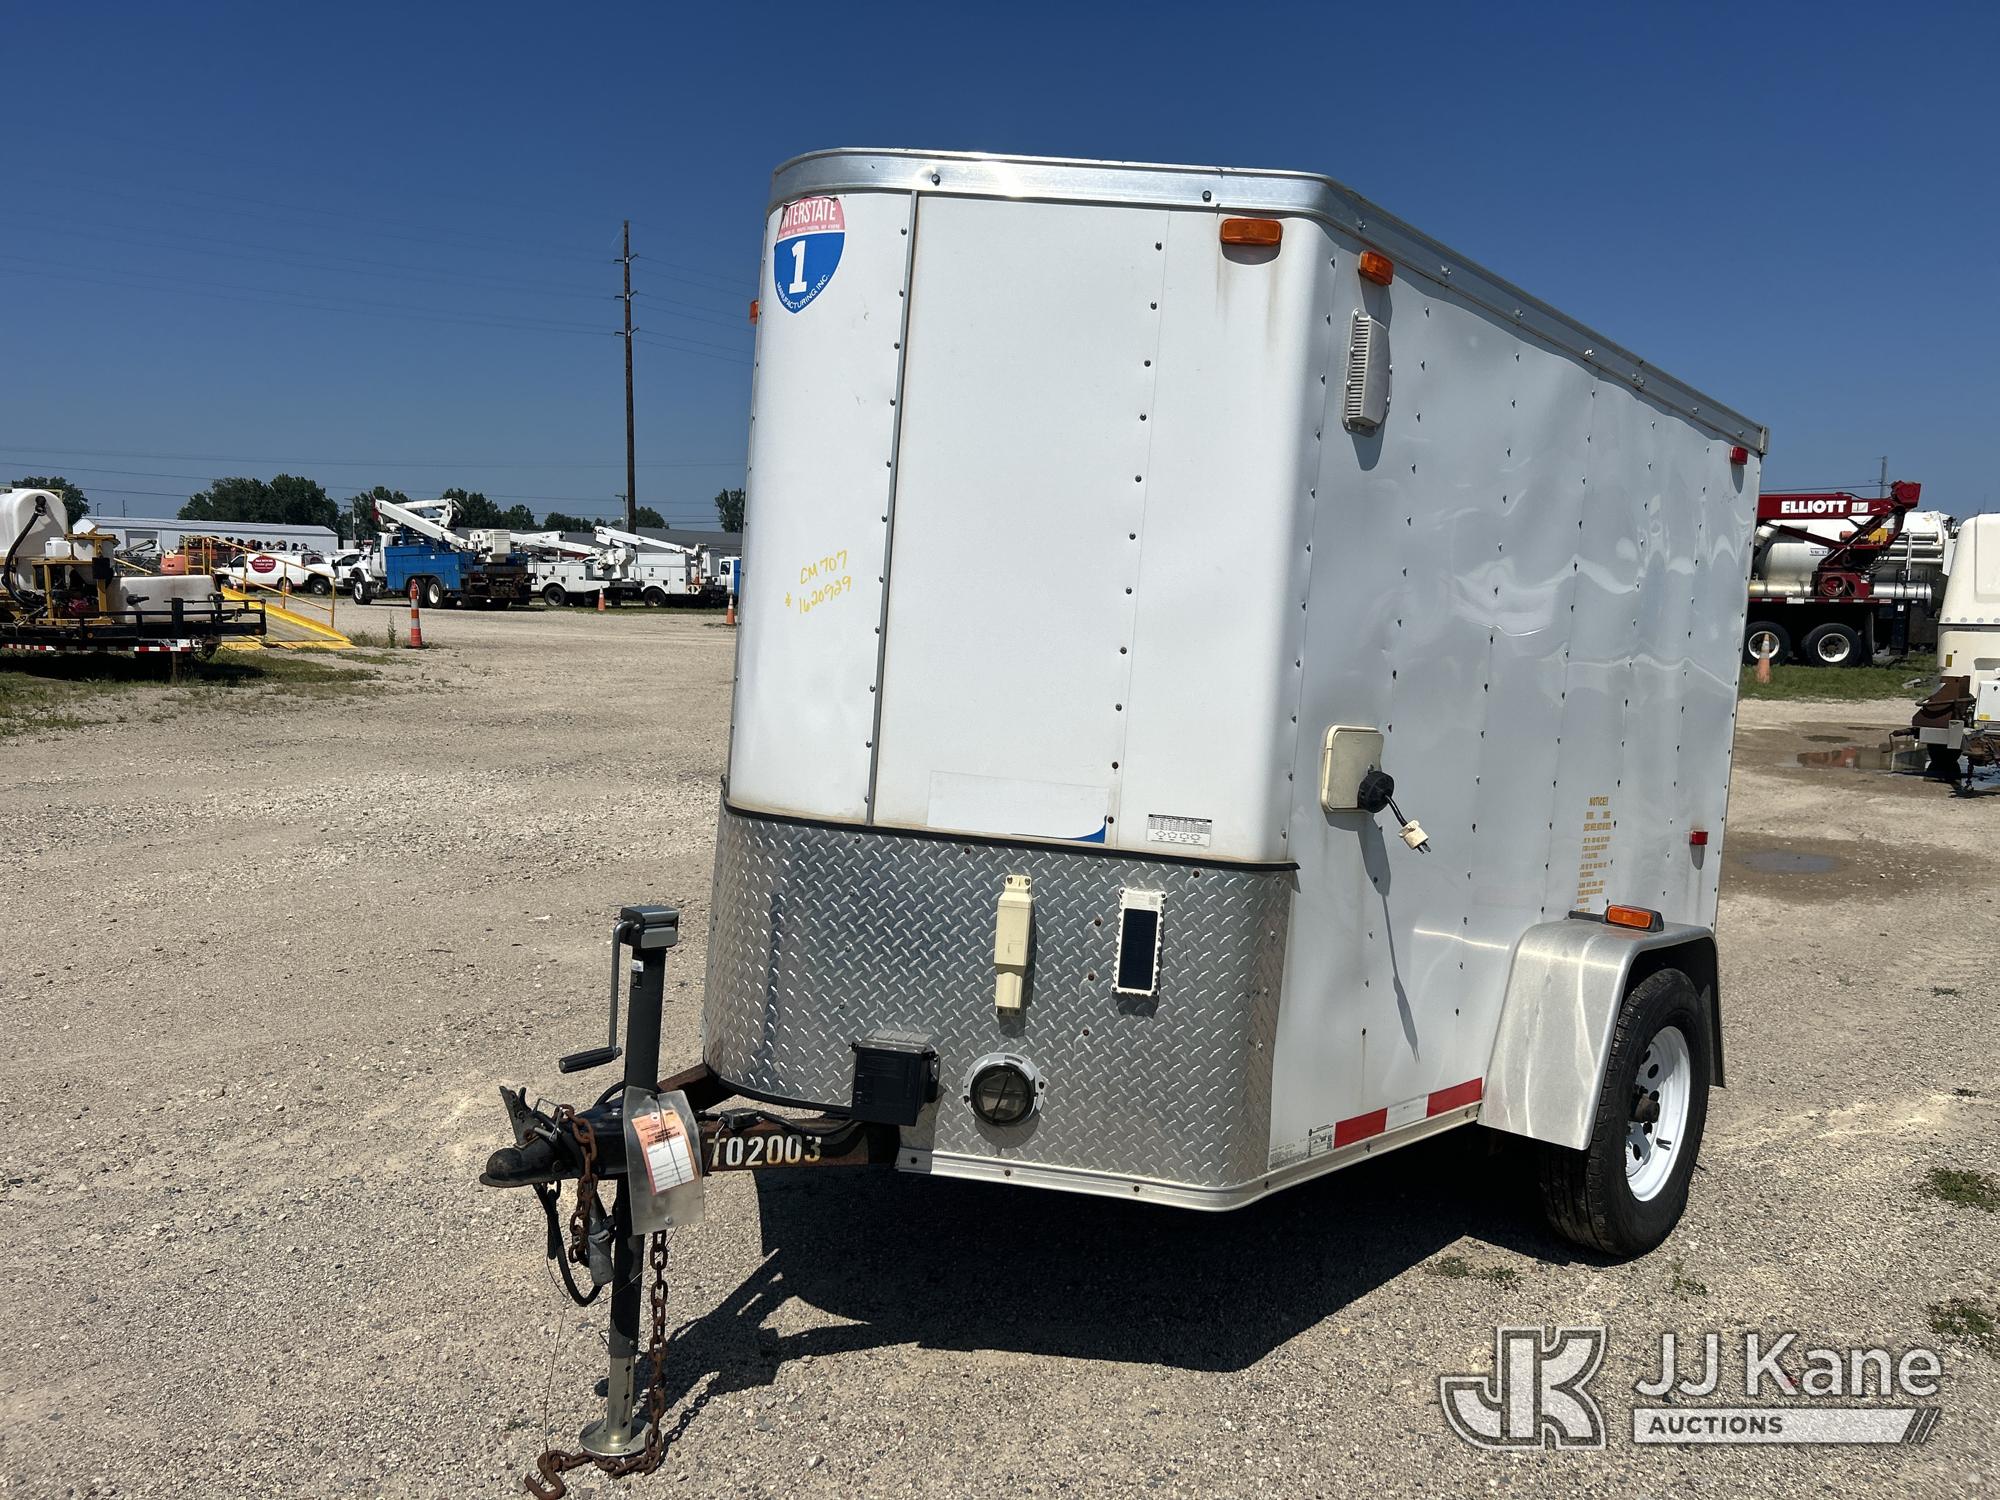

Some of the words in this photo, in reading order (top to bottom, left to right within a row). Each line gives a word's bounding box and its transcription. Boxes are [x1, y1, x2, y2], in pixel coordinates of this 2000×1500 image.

[789, 240, 806, 294] 1
[1781, 500, 1847, 514] ELLIOTT
[820, 549, 848, 572] 707
[707, 1134, 822, 1168] T02003
